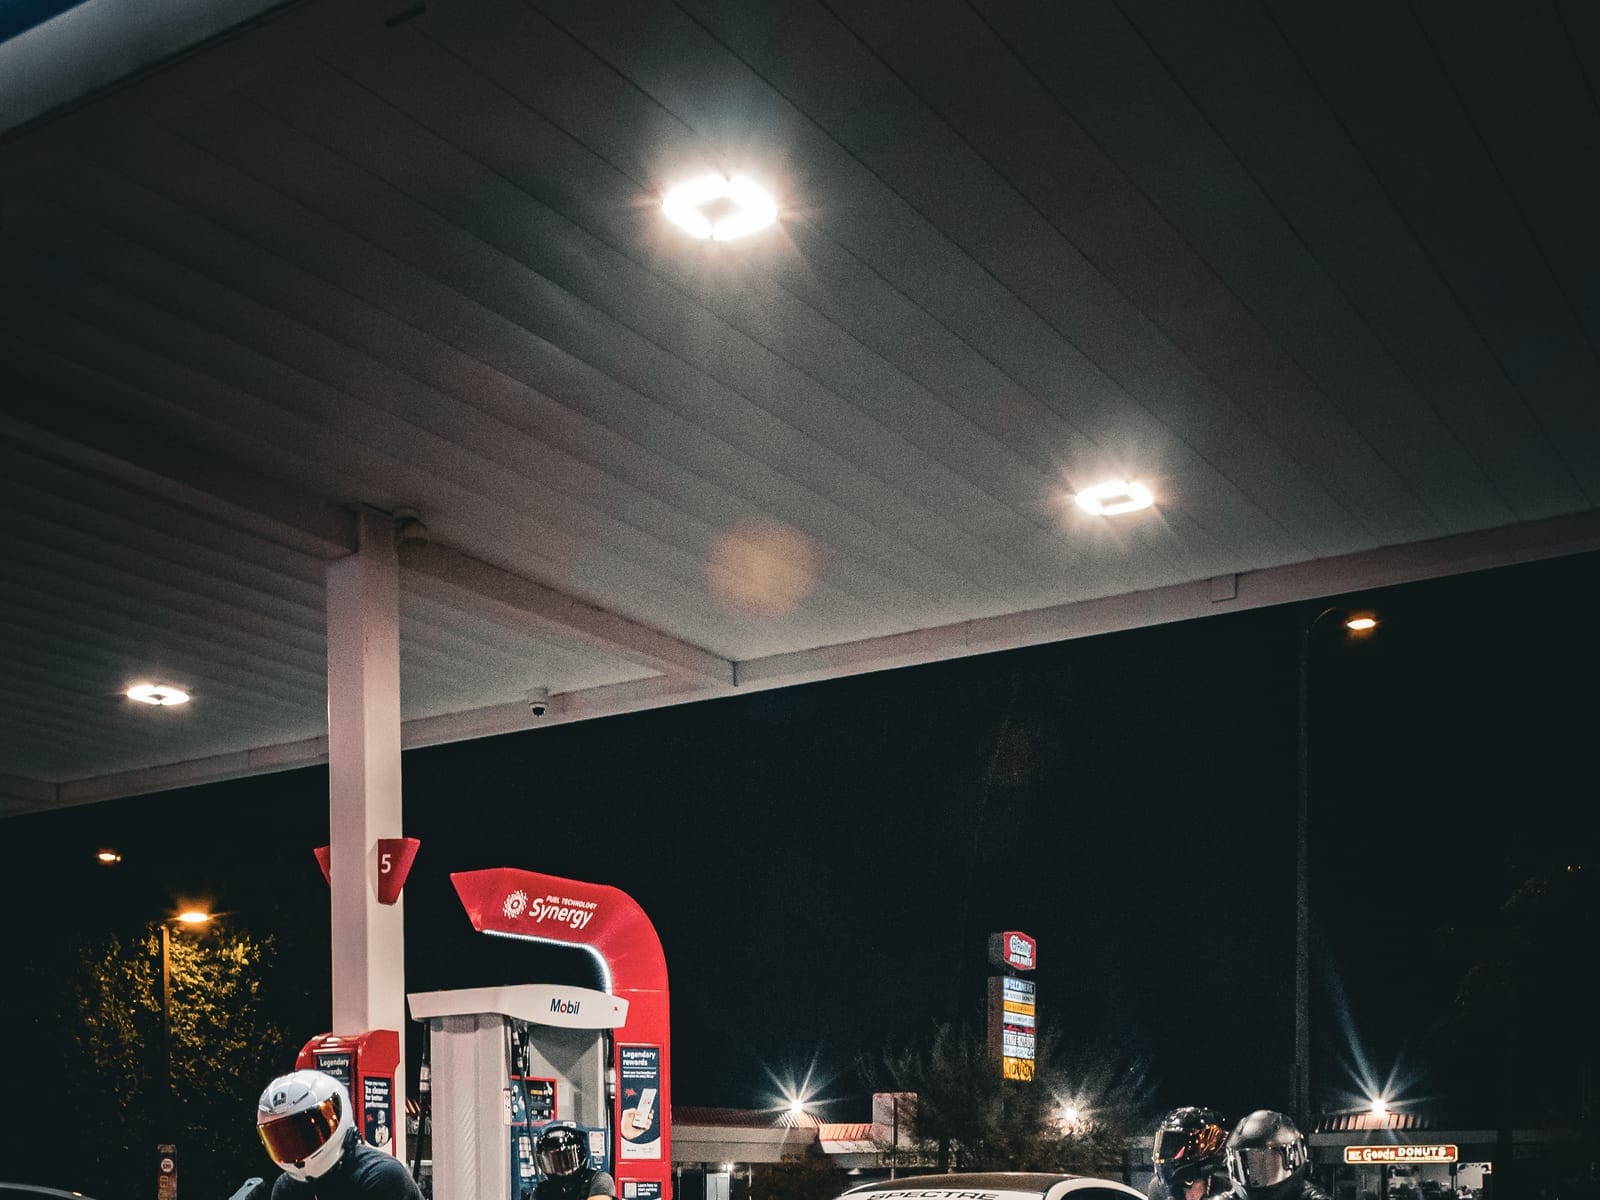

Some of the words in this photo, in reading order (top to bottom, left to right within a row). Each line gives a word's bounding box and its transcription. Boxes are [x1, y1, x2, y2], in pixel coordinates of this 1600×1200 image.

[381, 853, 391, 874] 5
[546, 895, 561, 904] FUEL
[561, 897, 598, 910] TECHNOLOGY
[528, 898, 594, 930] Synergy
[550, 998, 580, 1015] Mobil
[319, 1058, 349, 1067] Legendary
[622, 1050, 656, 1060] Legendary
[1362, 1149, 1396, 1162] Goods
[1398, 1147, 1447, 1157] DONUTS
